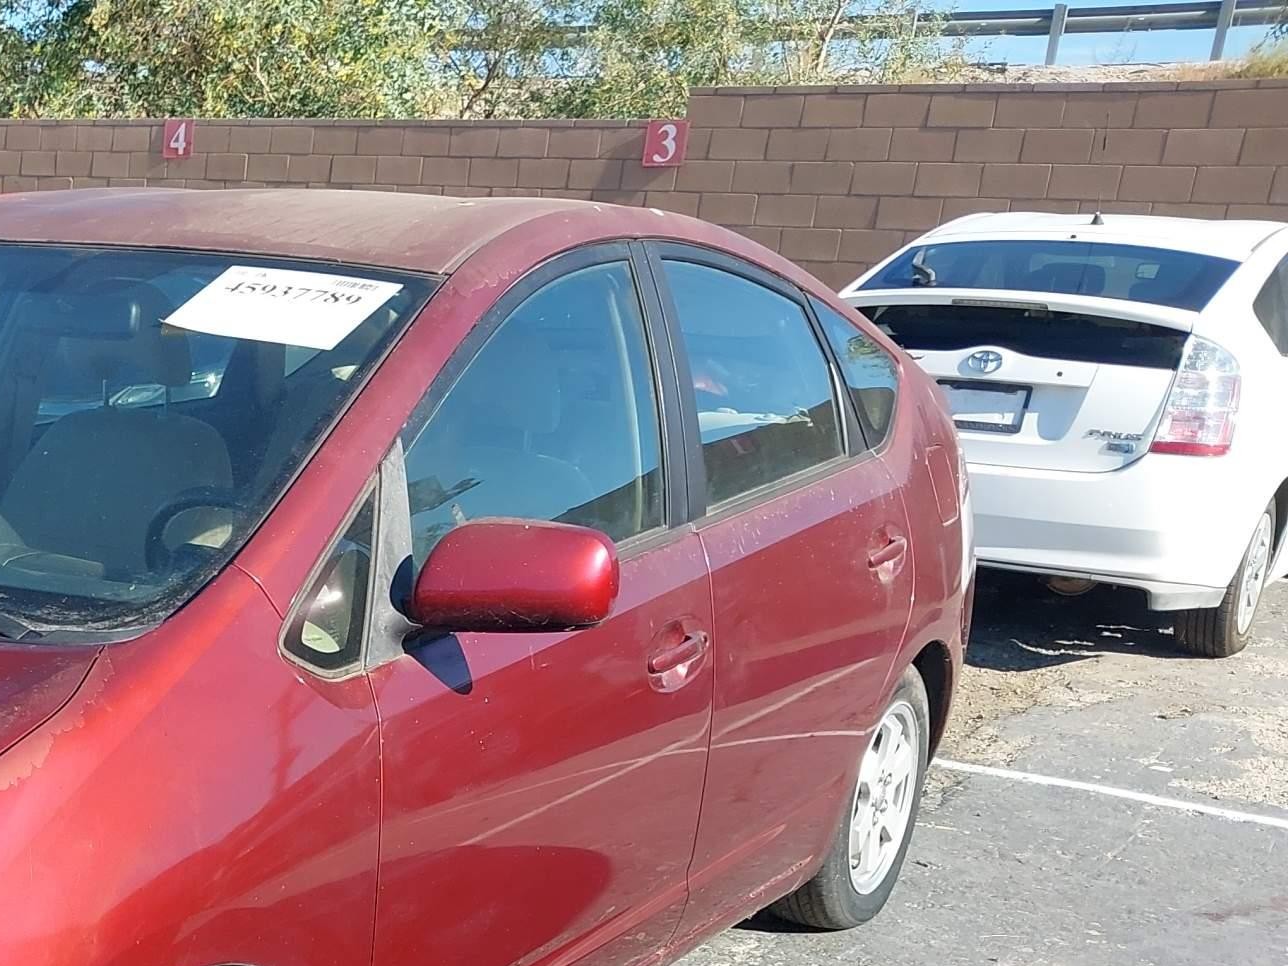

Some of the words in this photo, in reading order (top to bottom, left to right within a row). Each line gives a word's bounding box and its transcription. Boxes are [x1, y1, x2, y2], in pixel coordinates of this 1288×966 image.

[169, 122, 187, 155] 4
[652, 123, 678, 163] 3
[224, 281, 363, 305] 45937789
